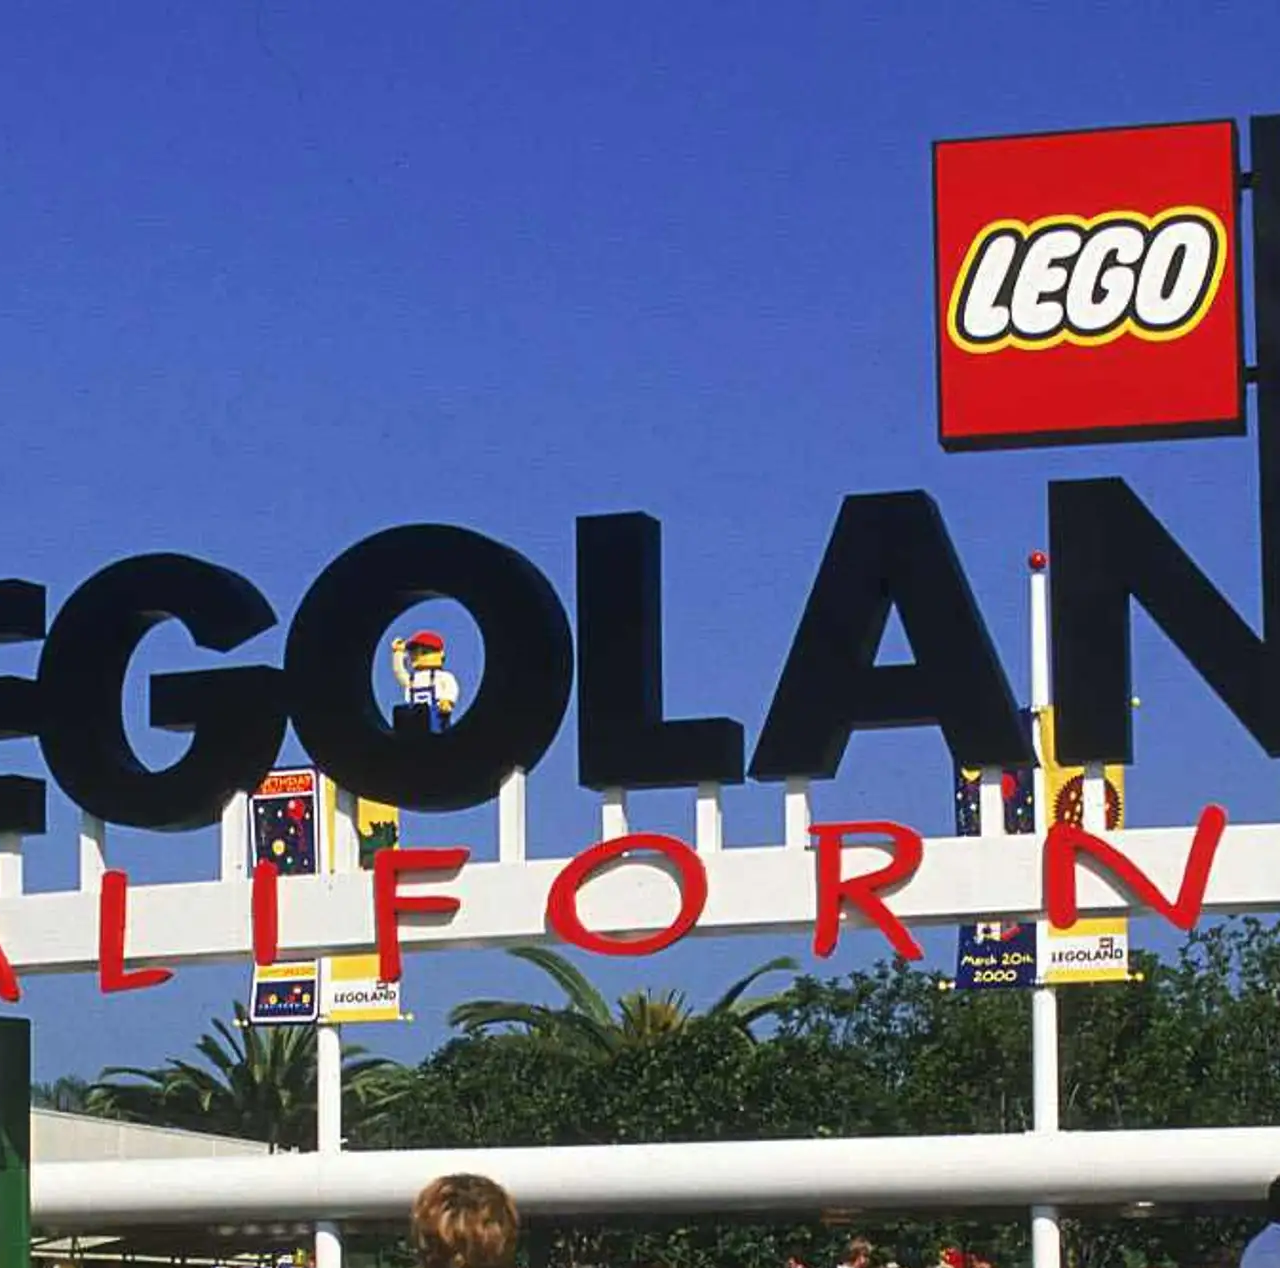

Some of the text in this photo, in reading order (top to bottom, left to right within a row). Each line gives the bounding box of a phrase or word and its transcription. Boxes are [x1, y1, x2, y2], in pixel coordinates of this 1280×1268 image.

[956, 213, 1218, 344] LEGO
[961, 952, 1034, 966] March 20th
[1051, 947, 1123, 963] LEGOLAND
[973, 969, 1018, 983] 2000
[334, 988, 397, 1003] LEGOLAND
